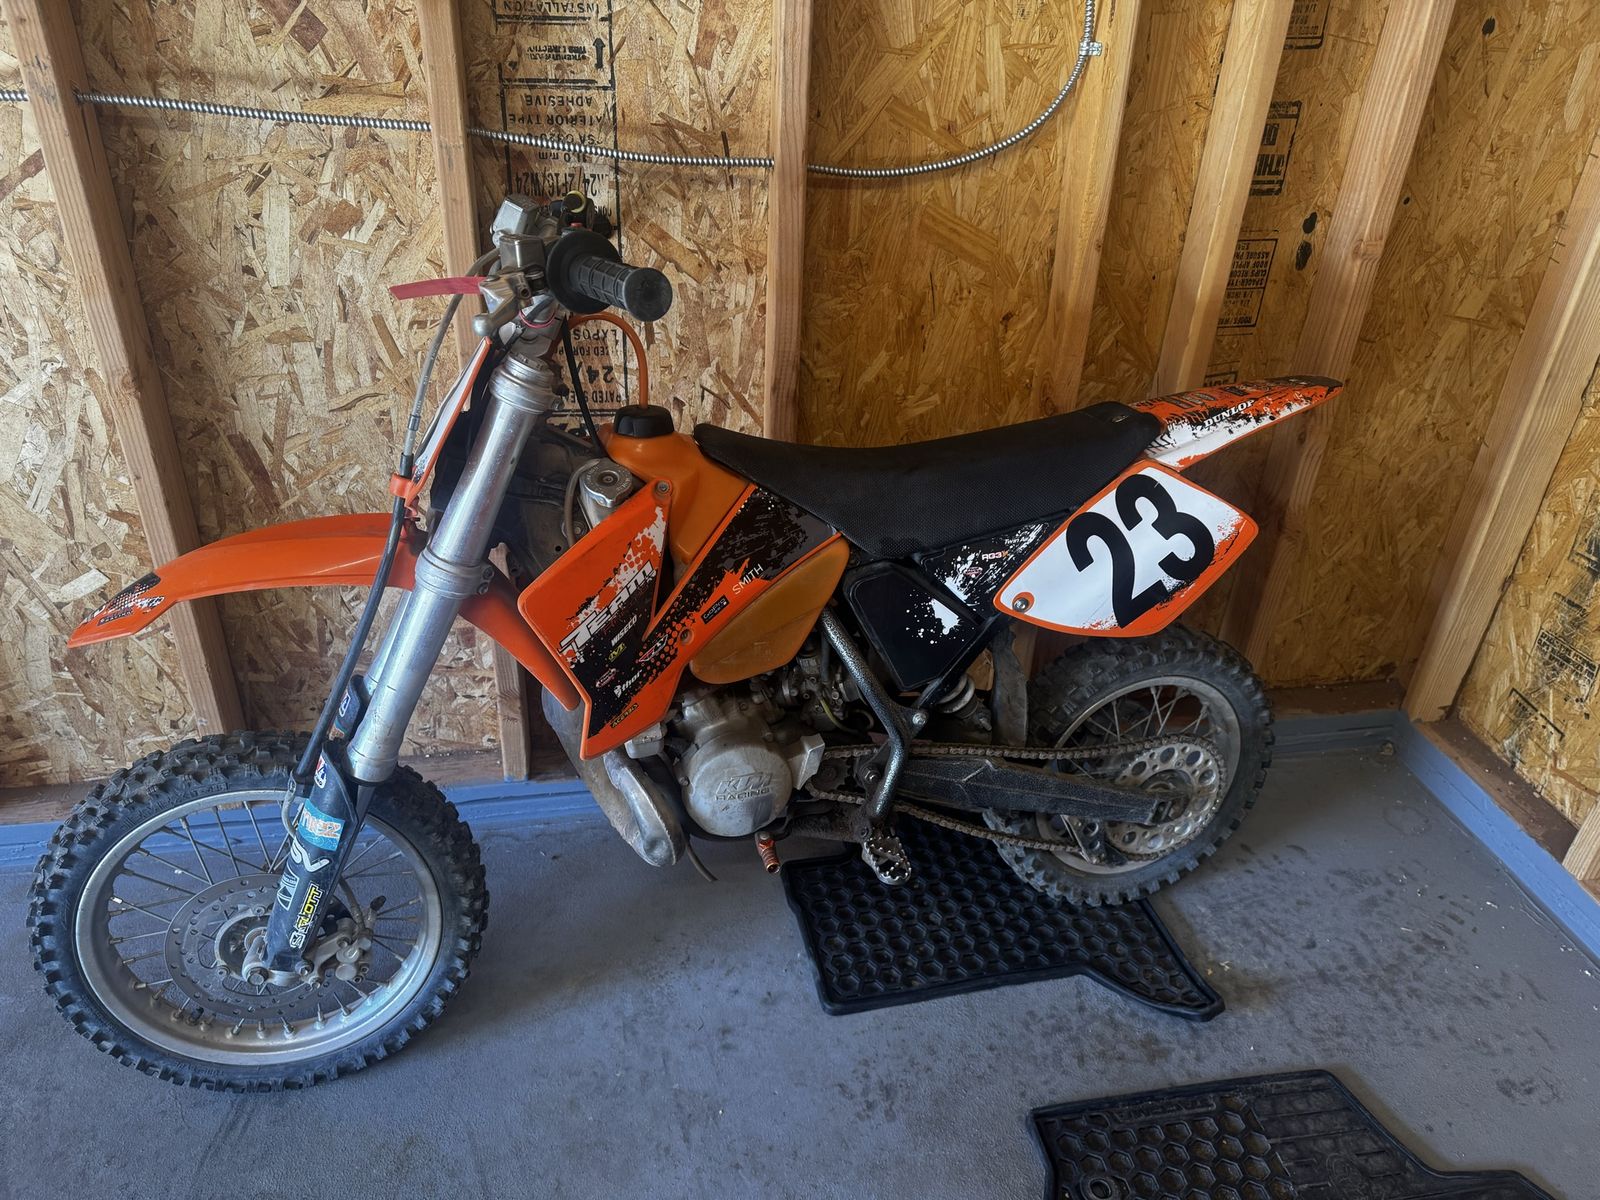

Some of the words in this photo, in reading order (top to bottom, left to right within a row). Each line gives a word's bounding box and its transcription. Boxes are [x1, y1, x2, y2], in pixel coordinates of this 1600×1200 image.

[503, 1, 599, 14] INSTALLATION
[525, 94, 593, 107] ADHESIVE
[508, 113, 542, 126] TYPE
[592, 390, 622, 404] RATED
[1203, 399, 1255, 428] DUNLOP
[1065, 473, 1215, 629] 23
[732, 563, 764, 595] SMITH
[611, 614, 638, 647] WISECO
[714, 786, 771, 801] RACING
